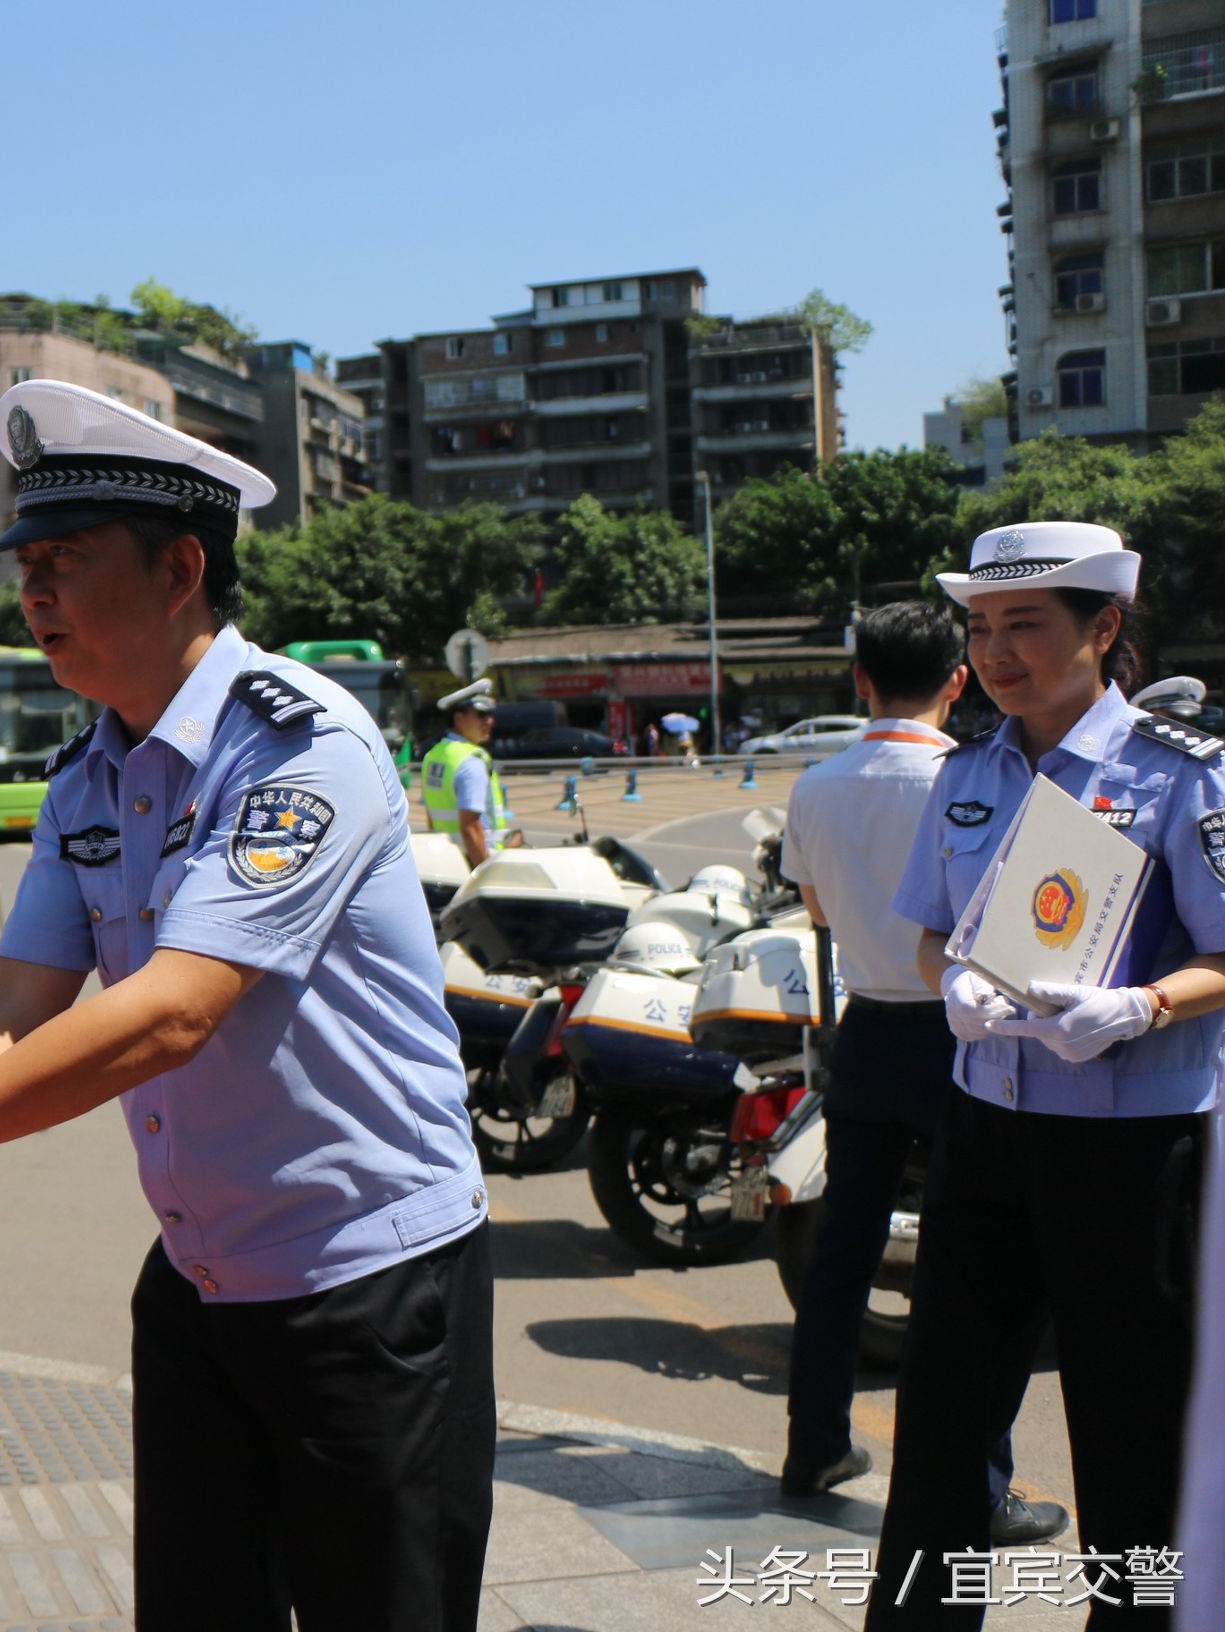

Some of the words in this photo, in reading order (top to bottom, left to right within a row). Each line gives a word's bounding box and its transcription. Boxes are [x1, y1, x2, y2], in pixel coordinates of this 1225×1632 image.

[249, 790, 333, 825] 中华人民共和国
[246, 809, 270, 830] 警
[298, 818, 321, 840] 察
[647, 943, 683, 955] POLICE
